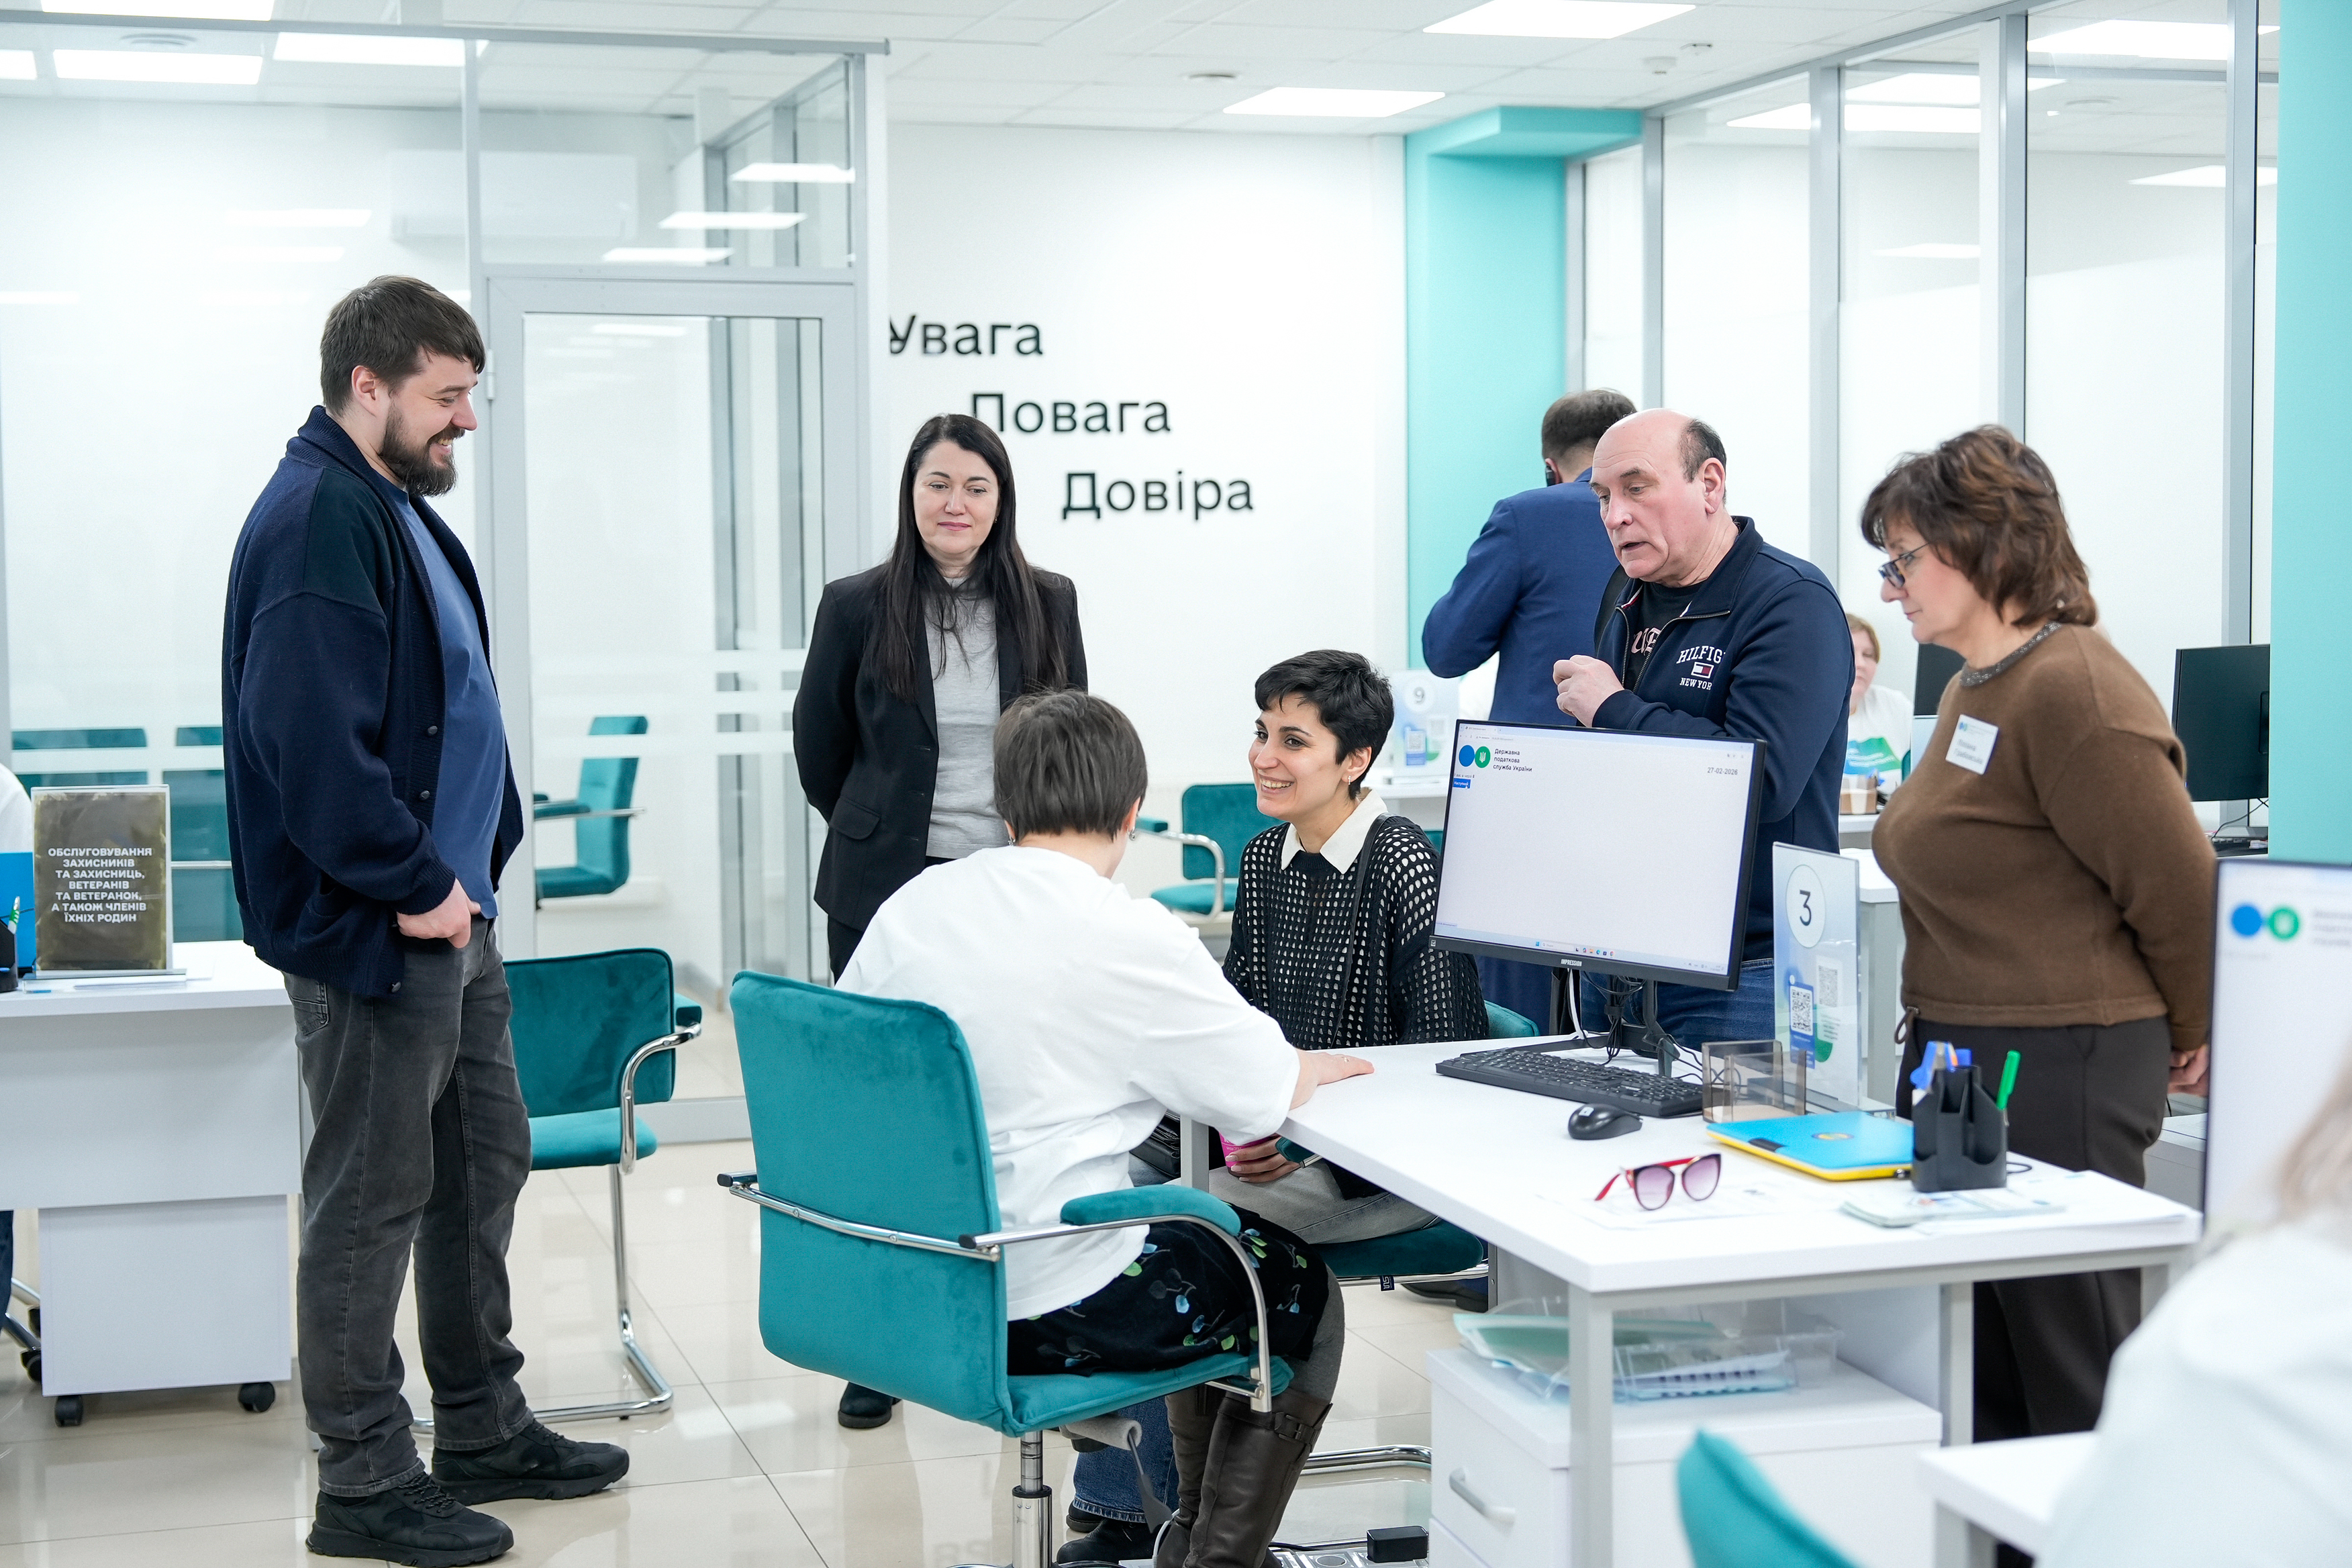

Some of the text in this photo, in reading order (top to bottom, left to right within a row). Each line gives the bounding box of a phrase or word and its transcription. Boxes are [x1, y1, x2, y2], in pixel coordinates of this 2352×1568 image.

[889, 315, 1043, 356] Увага
[972, 392, 1171, 433] Повага
[1062, 471, 1253, 521] Довіра
[1676, 645, 1726, 664] HILFIG
[1679, 677, 1698, 687] NEW
[1414, 686, 1426, 703] 9
[1707, 767, 1738, 775] 27-02-2026
[48, 847, 152, 856] ОБСЛУГОВУВАННЯ
[63, 859, 135, 867] ЗАХИСНИКІВ
[55, 869, 145, 879] ТА ЗАХИСНИЦЬ,
[68, 881, 130, 889] ВЕТЕРАНІВ
[55, 891, 142, 901] ТА ВЕТЕРАНОК,
[51, 902, 146, 912] А ТАКОЖ ЧЛЕНІВ
[1799, 889, 1812, 926] 3
[64, 912, 136, 924] ЇХНІХ РОДИН
[1561, 959, 1583, 967] IMPRESSION
